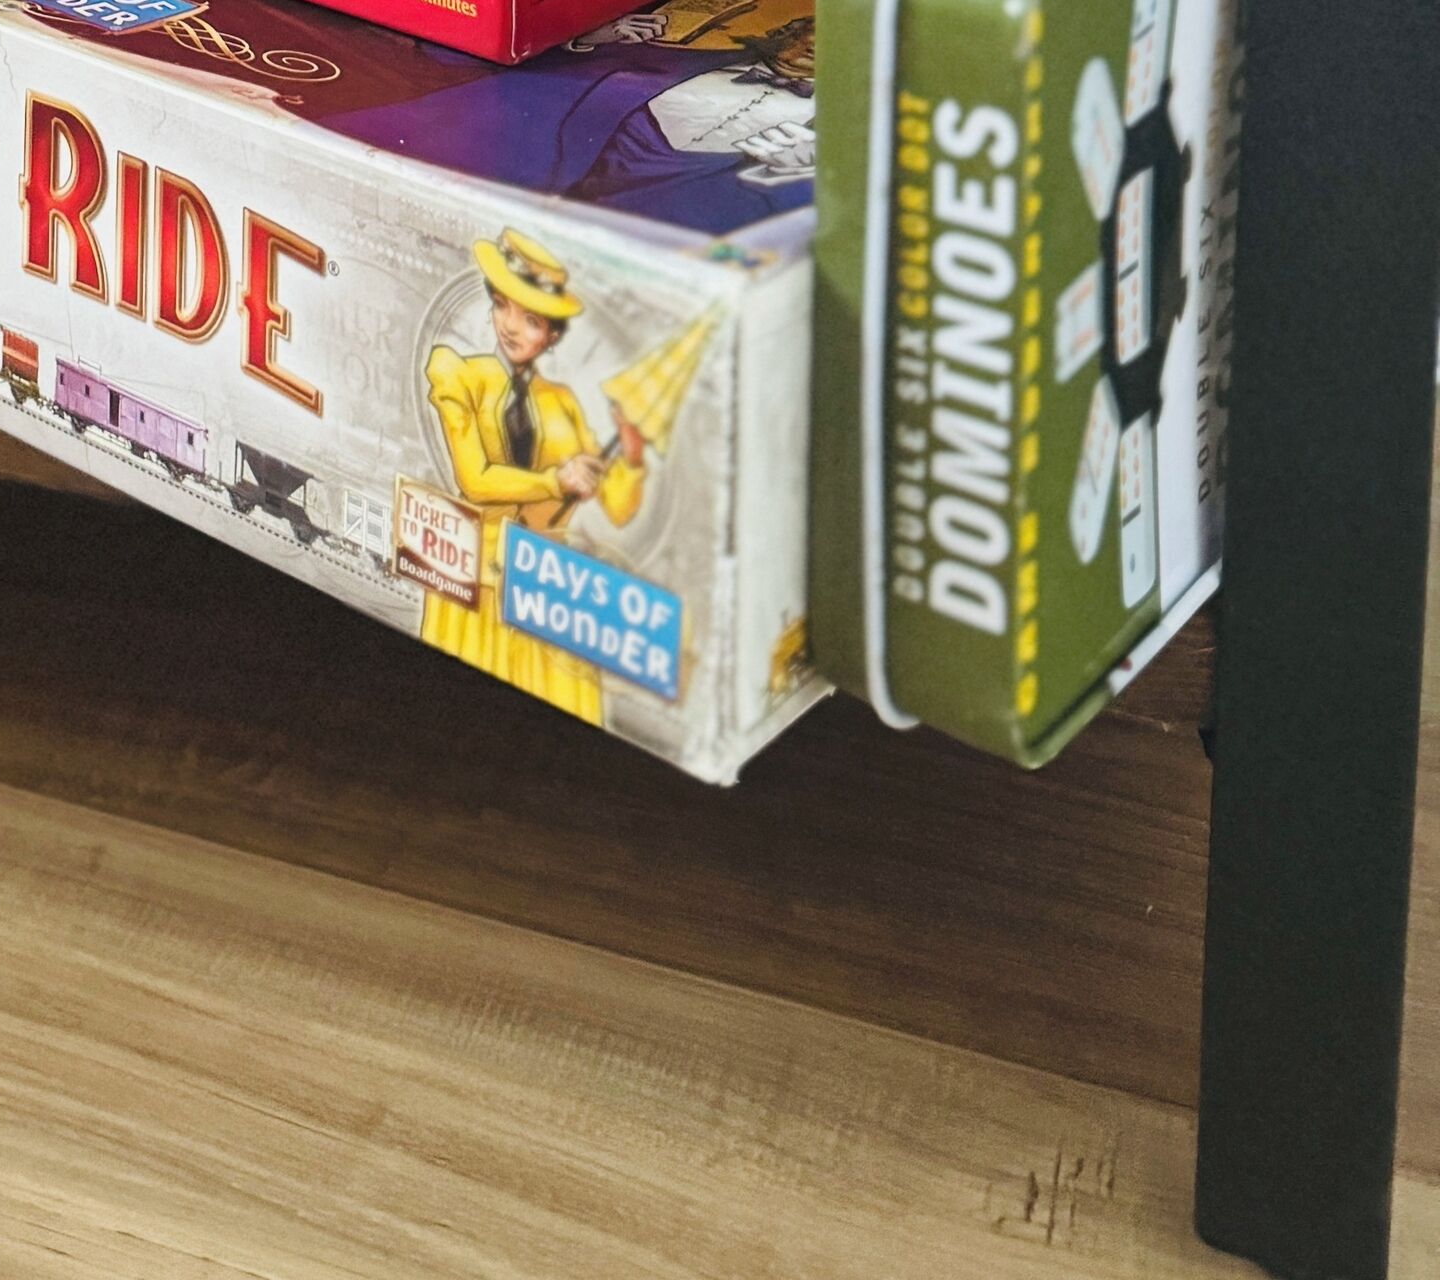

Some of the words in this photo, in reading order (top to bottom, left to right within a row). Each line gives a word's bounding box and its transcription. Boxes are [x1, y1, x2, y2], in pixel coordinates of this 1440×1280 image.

[898, 90, 932, 171] DOT
[18, 88, 327, 417] RIDE
[898, 184, 931, 319] COLOR
[1197, 200, 1215, 282] SIX
[897, 325, 929, 406] SIX
[929, 99, 1019, 636] DOMINOES
[1196, 305, 1213, 504] DOUBLE
[402, 490, 461, 536] TICKET
[402, 516, 417, 537] TO
[421, 527, 473, 578] RIDE
[894, 426, 927, 603] DOUBLE
[399, 556, 473, 602] Boardgame
[514, 539, 609, 604] DAYS
[619, 585, 673, 630] OF
